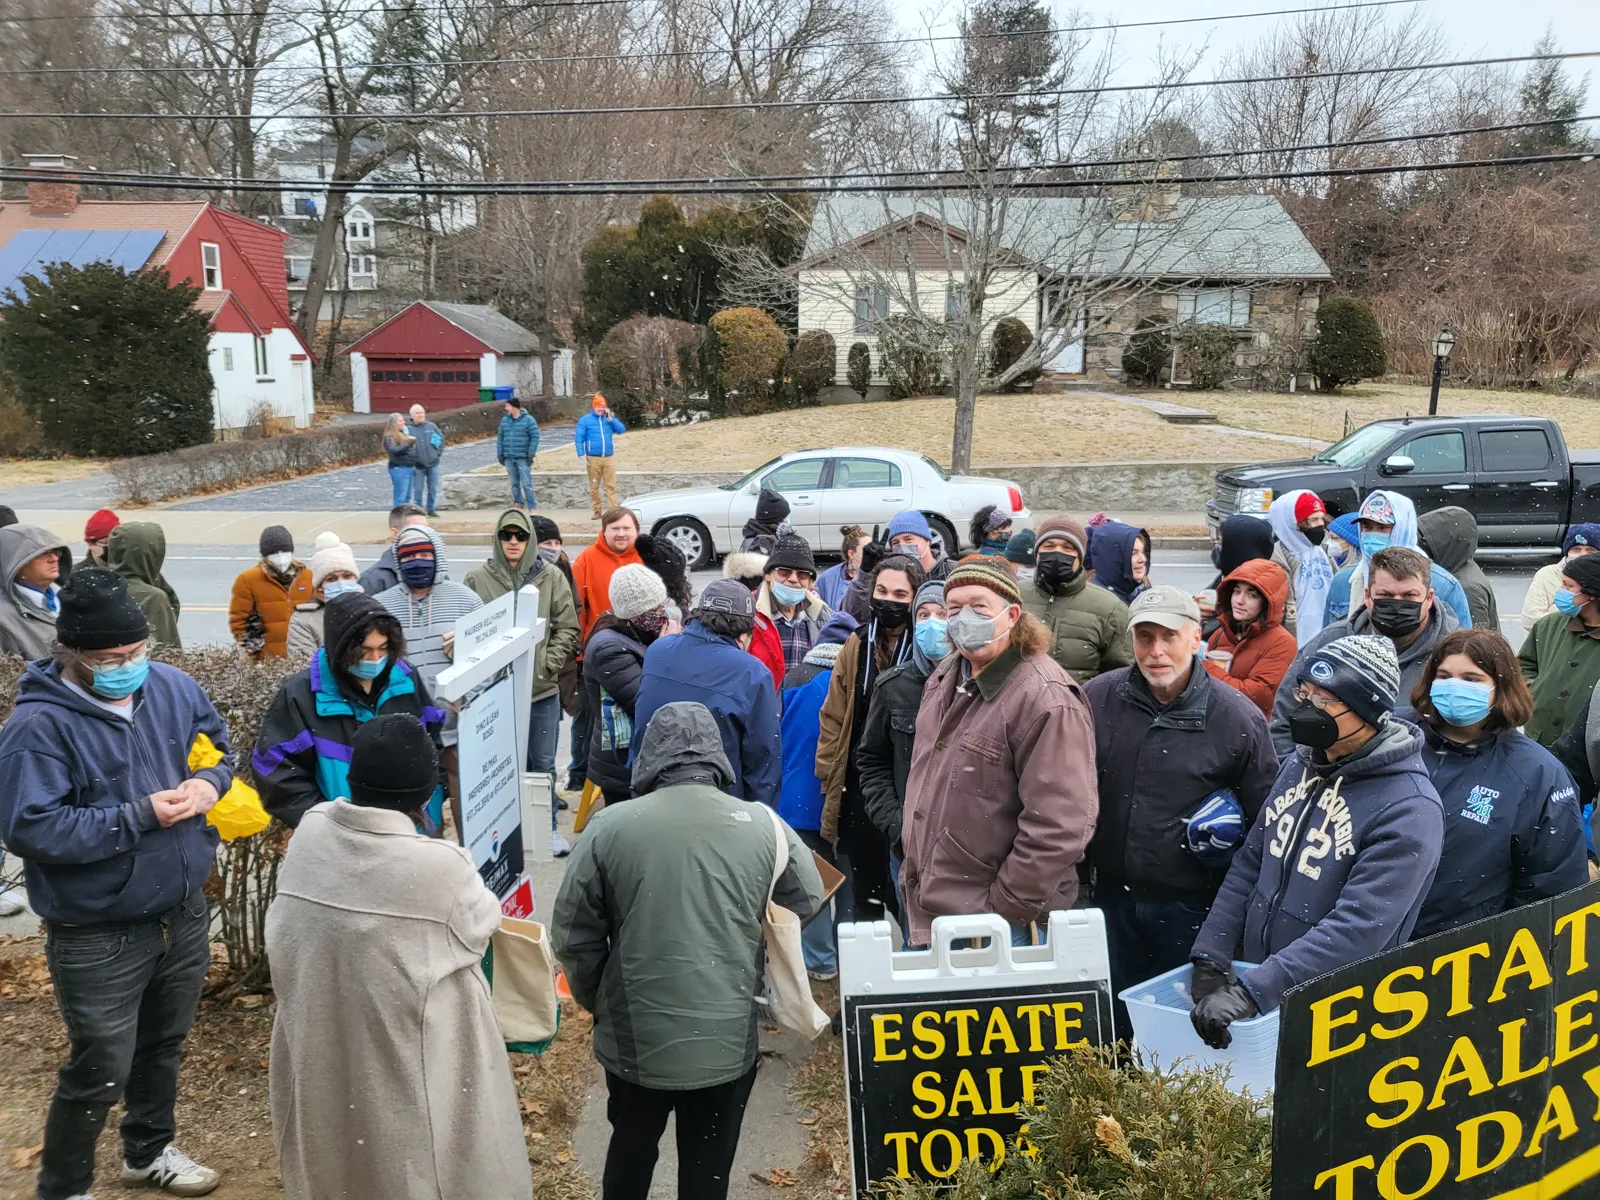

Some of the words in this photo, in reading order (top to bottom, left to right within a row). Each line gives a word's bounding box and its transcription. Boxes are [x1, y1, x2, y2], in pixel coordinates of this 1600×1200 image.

[490, 754, 512, 779] PROPERTIES
[1471, 784, 1500, 799] AUTO
[1460, 809, 1489, 825] REPAIR
[1306, 900, 1600, 1067] ESTAT
[870, 1002, 1088, 1062] ESTATE
[1365, 990, 1599, 1128] SALE
[883, 1125, 1043, 1179] TODA
